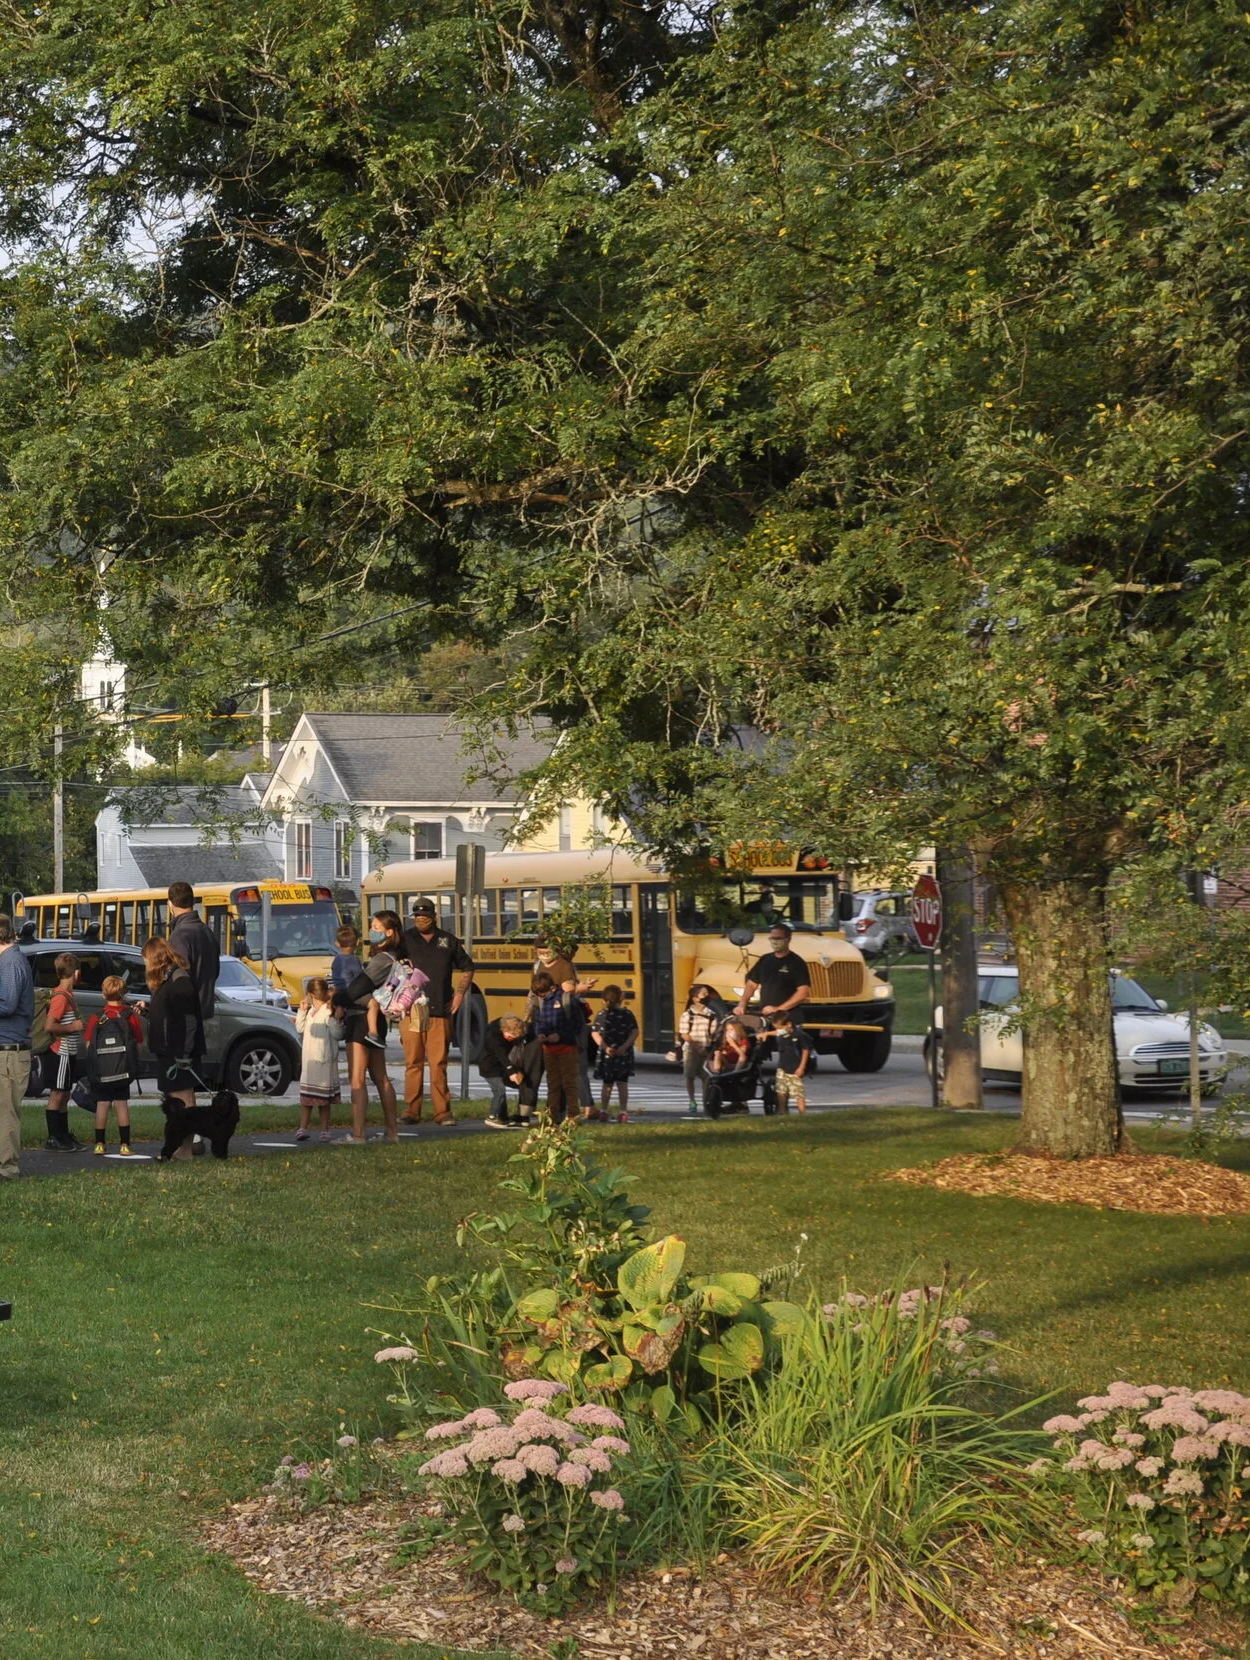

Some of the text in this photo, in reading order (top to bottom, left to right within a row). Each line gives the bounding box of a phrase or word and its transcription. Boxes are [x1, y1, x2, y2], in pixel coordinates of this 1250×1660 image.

[260, 889, 312, 900] SHOOL BUS
[913, 896, 940, 925] STOP
[513, 947, 529, 960] School
